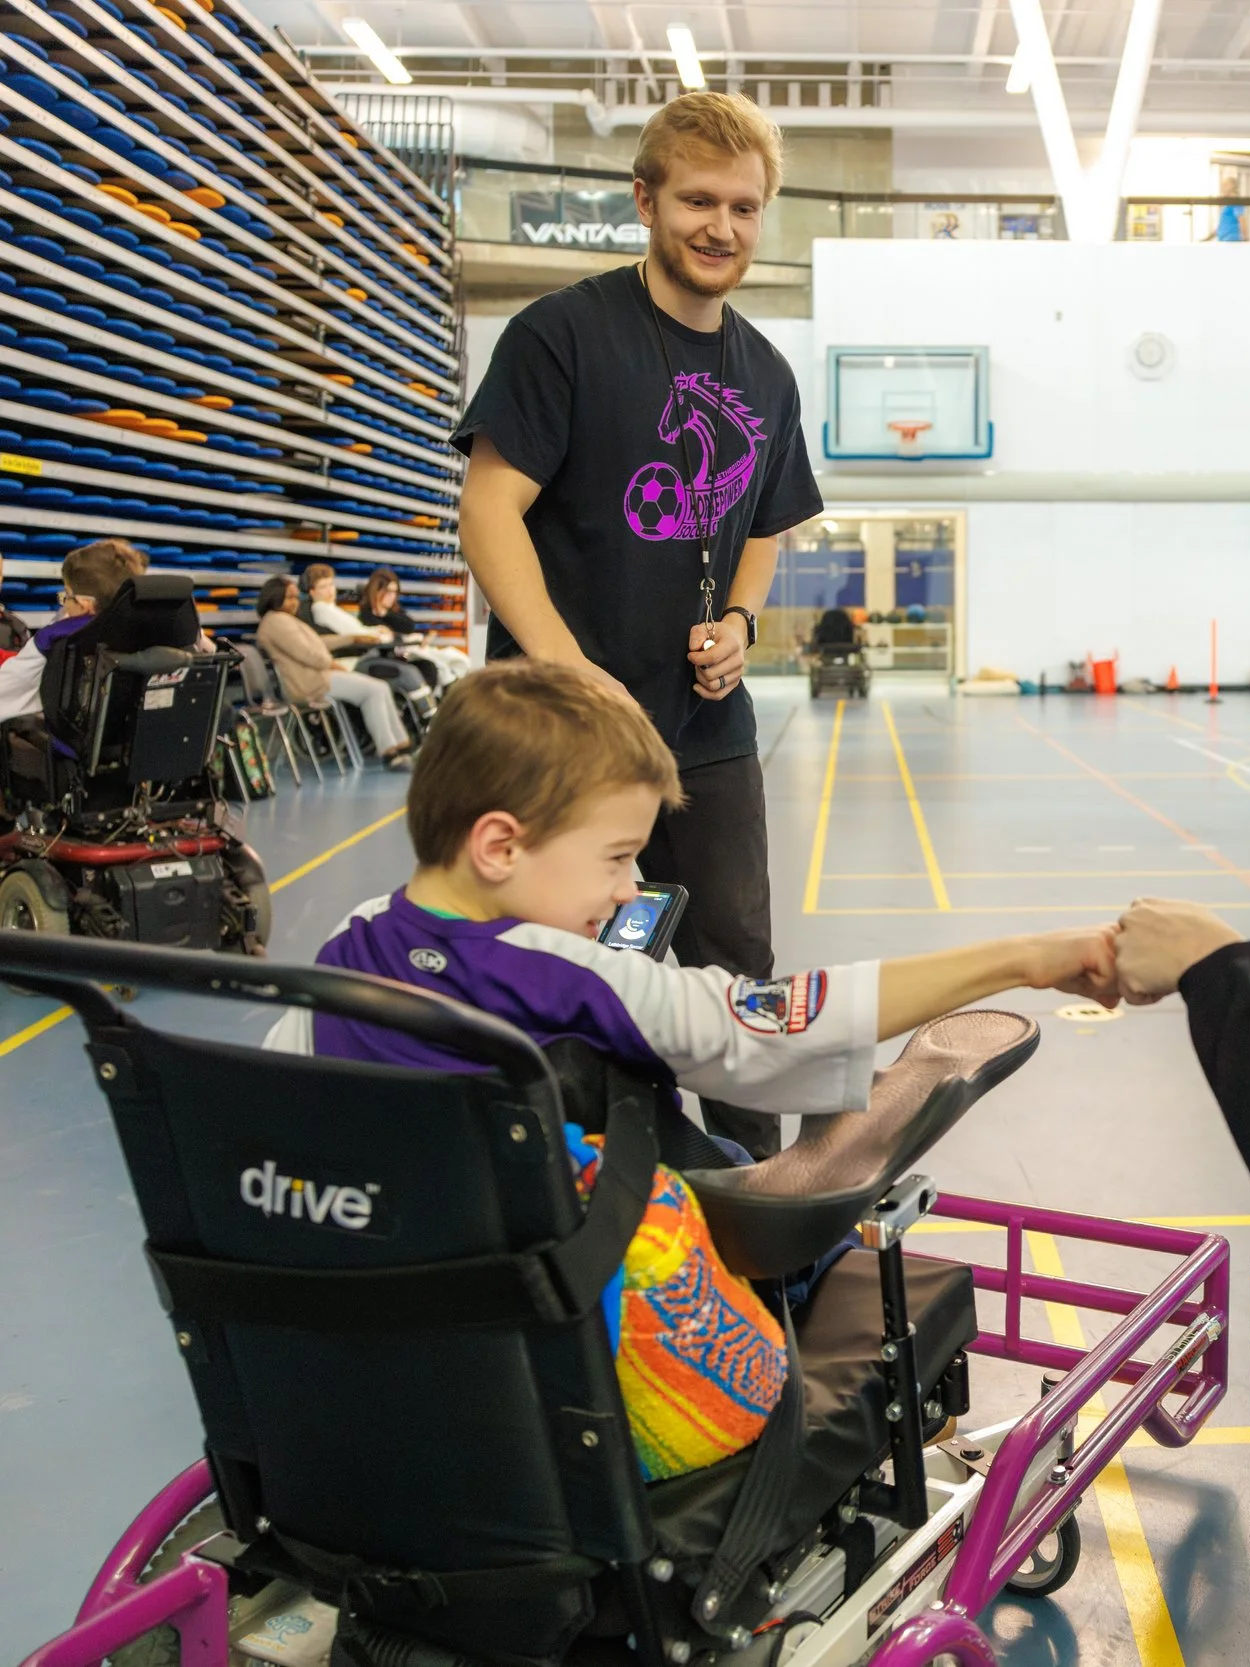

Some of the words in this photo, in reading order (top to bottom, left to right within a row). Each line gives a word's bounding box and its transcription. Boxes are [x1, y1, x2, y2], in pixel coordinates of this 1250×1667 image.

[521, 222, 649, 244] VANTAGE
[677, 524, 709, 538] SOCCE
[240, 1160, 373, 1230] drive
